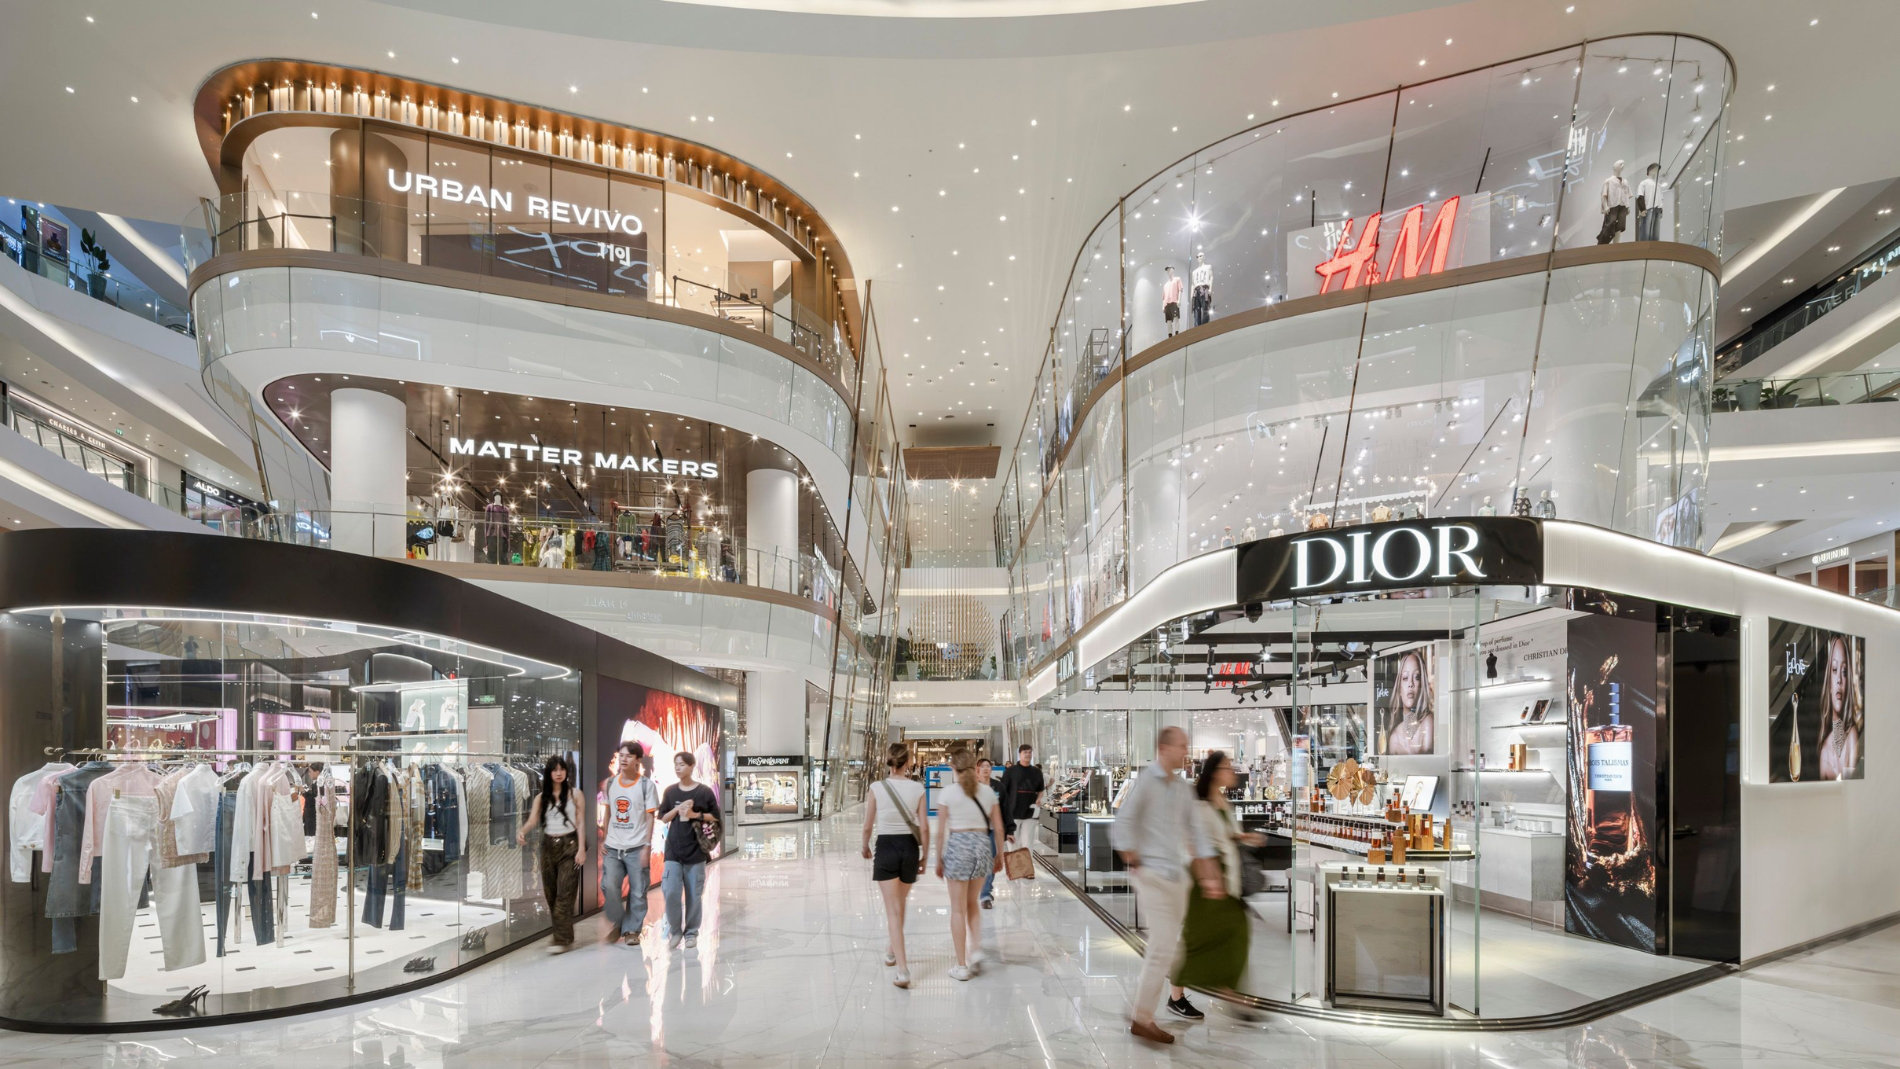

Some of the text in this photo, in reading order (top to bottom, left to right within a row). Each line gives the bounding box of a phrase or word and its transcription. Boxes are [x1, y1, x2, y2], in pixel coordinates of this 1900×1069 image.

[388, 167, 643, 235] URBAN REVIVO
[1315, 195, 1460, 294] H&M
[449, 436, 719, 478] MATTER MAKERS
[194, 481, 220, 497] ALDO
[1289, 525, 1488, 590] DIOR
[1523, 648, 1559, 661] CHRISTIAN
